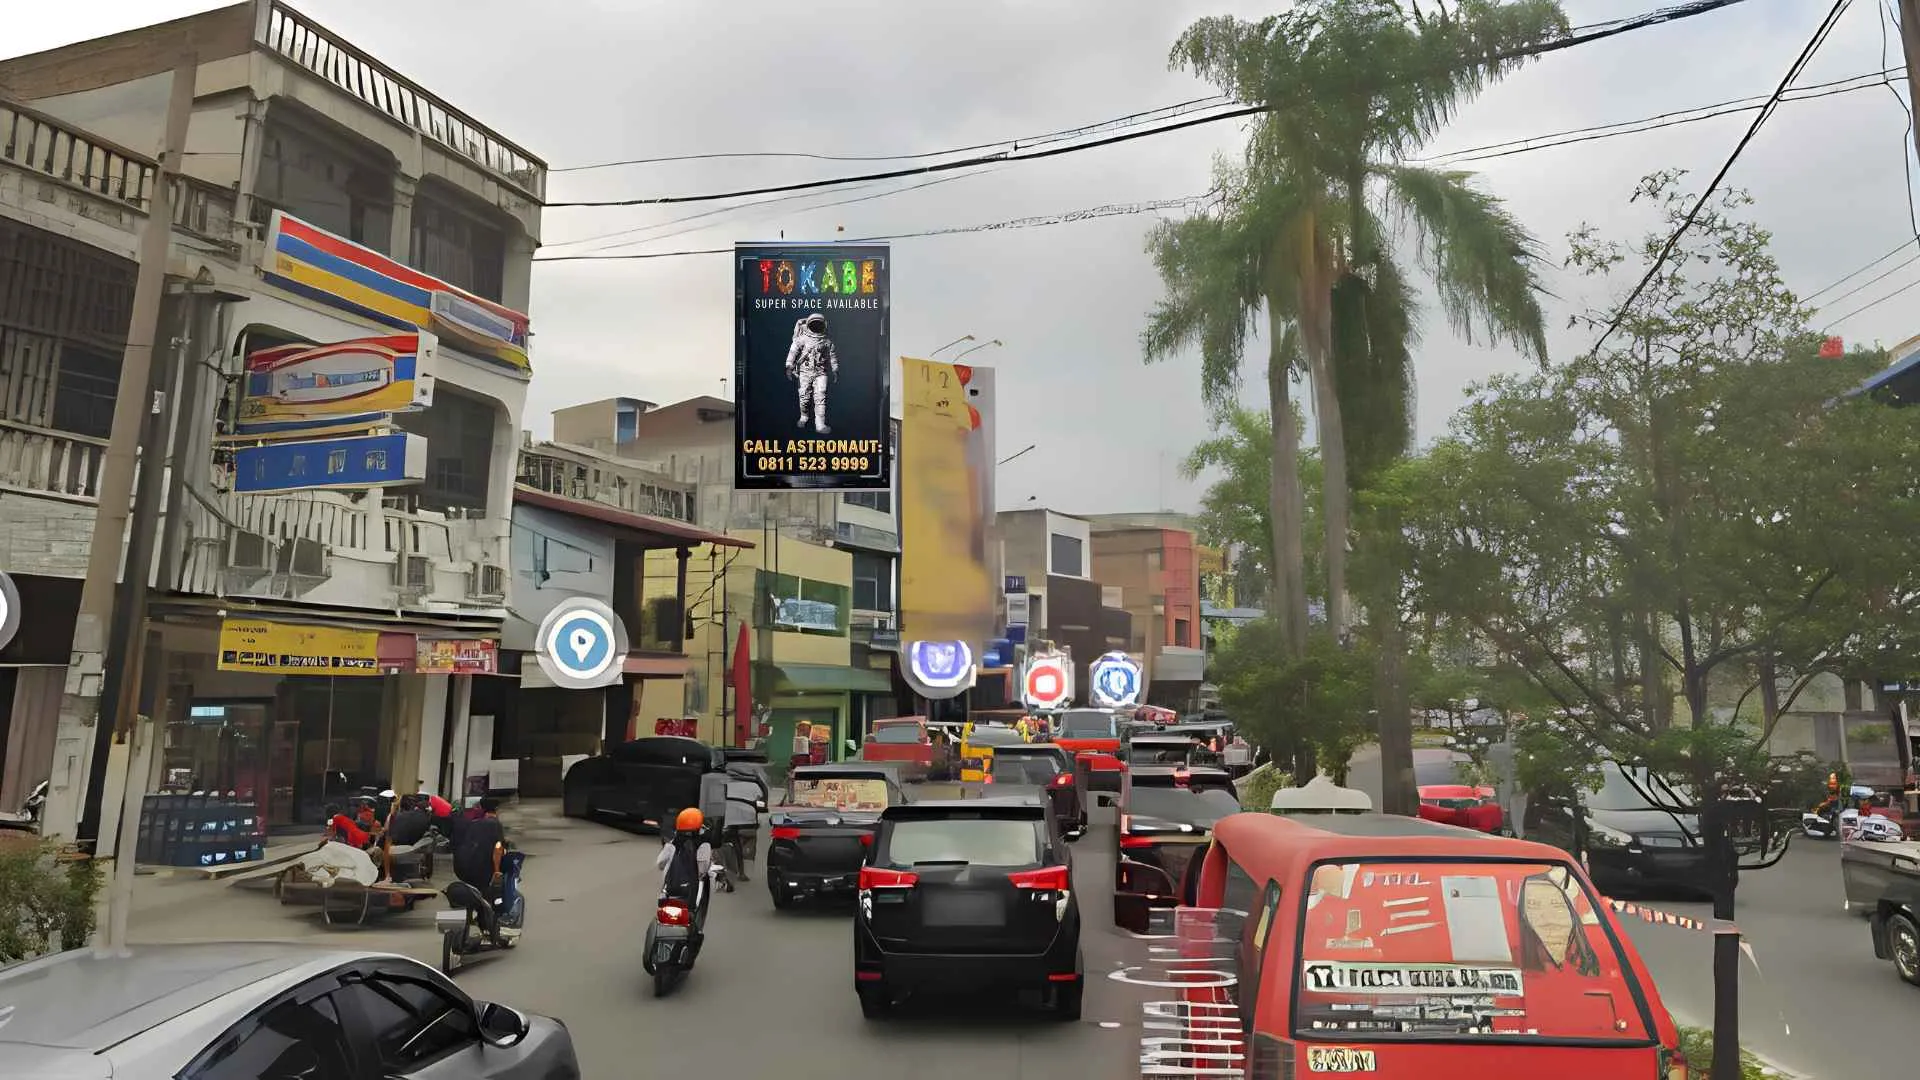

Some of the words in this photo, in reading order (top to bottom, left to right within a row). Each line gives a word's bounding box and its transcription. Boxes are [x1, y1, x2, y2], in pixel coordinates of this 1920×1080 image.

[759, 258, 878, 296] TOKABE
[755, 298, 786, 309] SUPER
[791, 298, 822, 309] SPACE
[826, 298, 879, 309] AVAILABLE
[743, 439, 782, 454] CALL
[786, 439, 883, 454] ASTRONAUT:
[758, 456, 793, 471] 0811
[799, 456, 827, 471] 523
[831, 456, 869, 471] 9999
